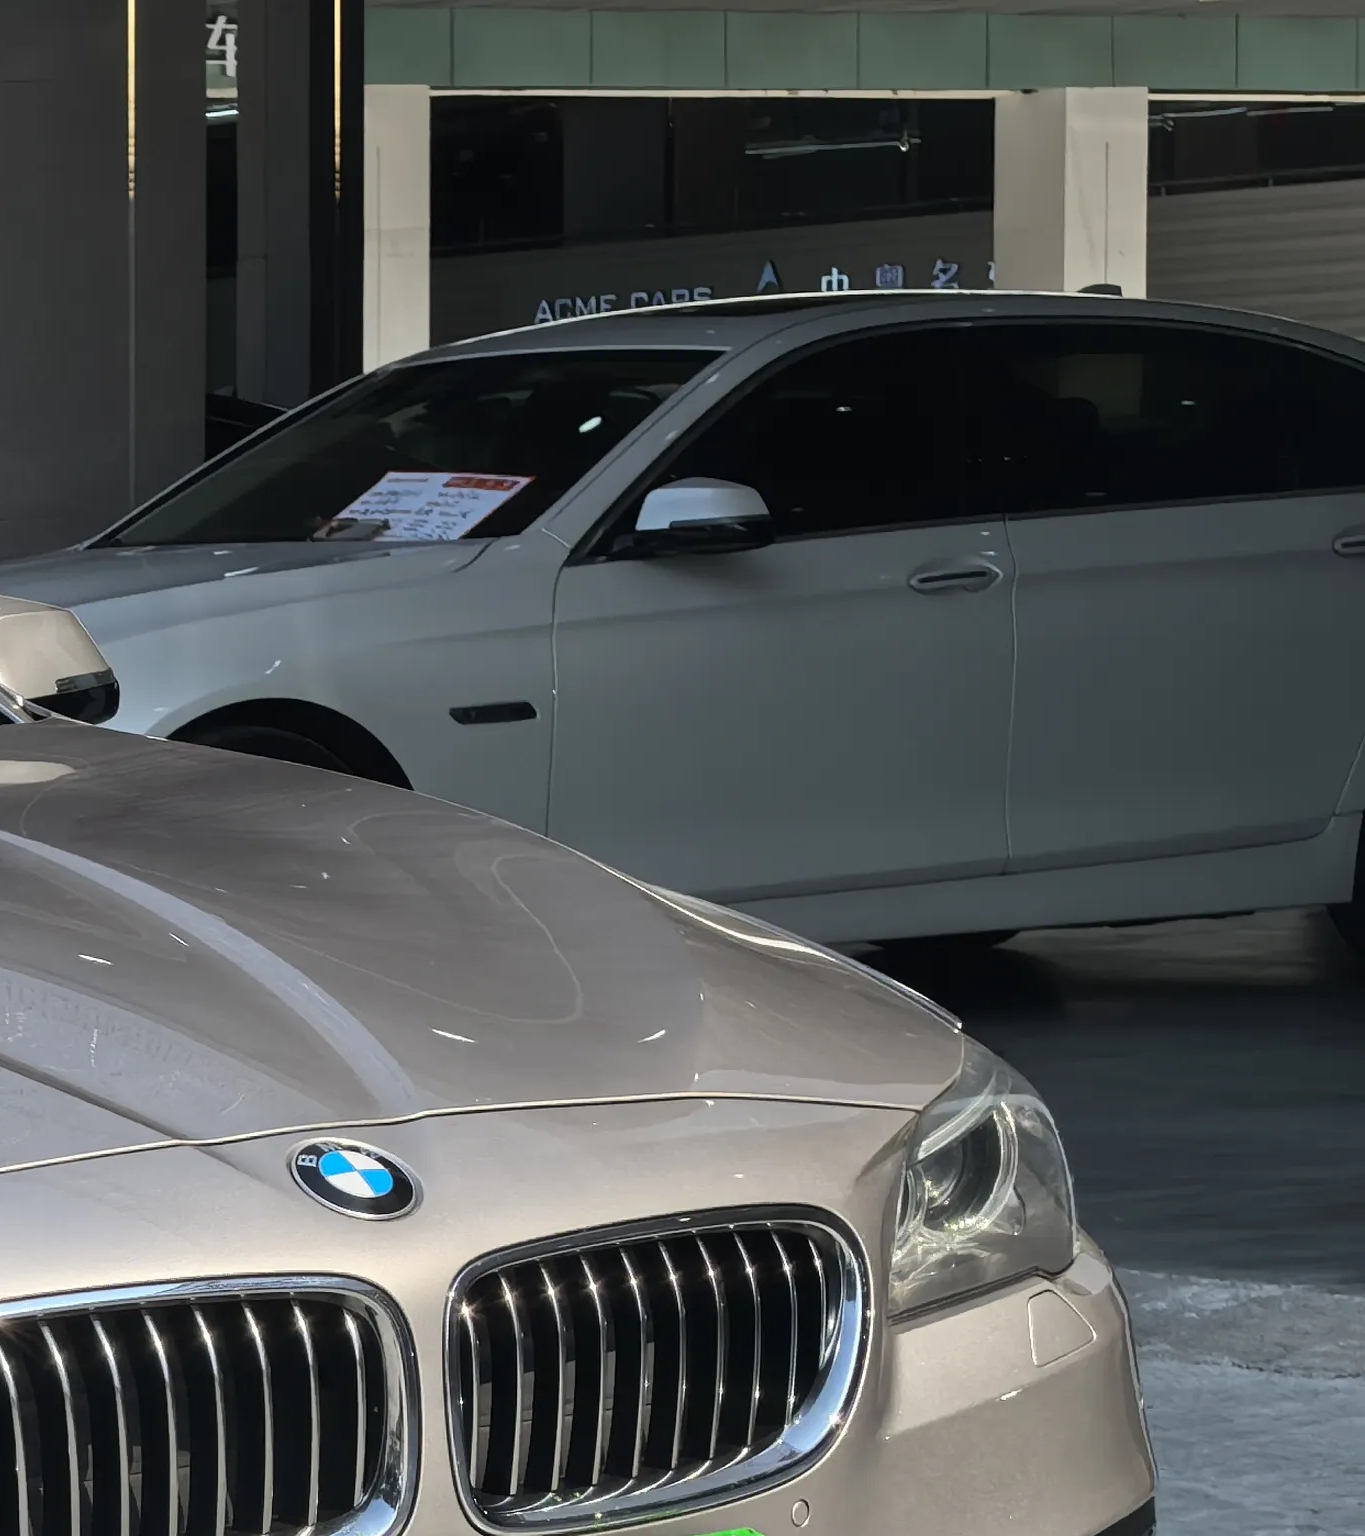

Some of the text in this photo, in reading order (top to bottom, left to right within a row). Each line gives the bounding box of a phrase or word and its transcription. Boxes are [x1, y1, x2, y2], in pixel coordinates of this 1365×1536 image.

[820, 257, 996, 292] 中粤名
[533, 293, 618, 324] ACME
